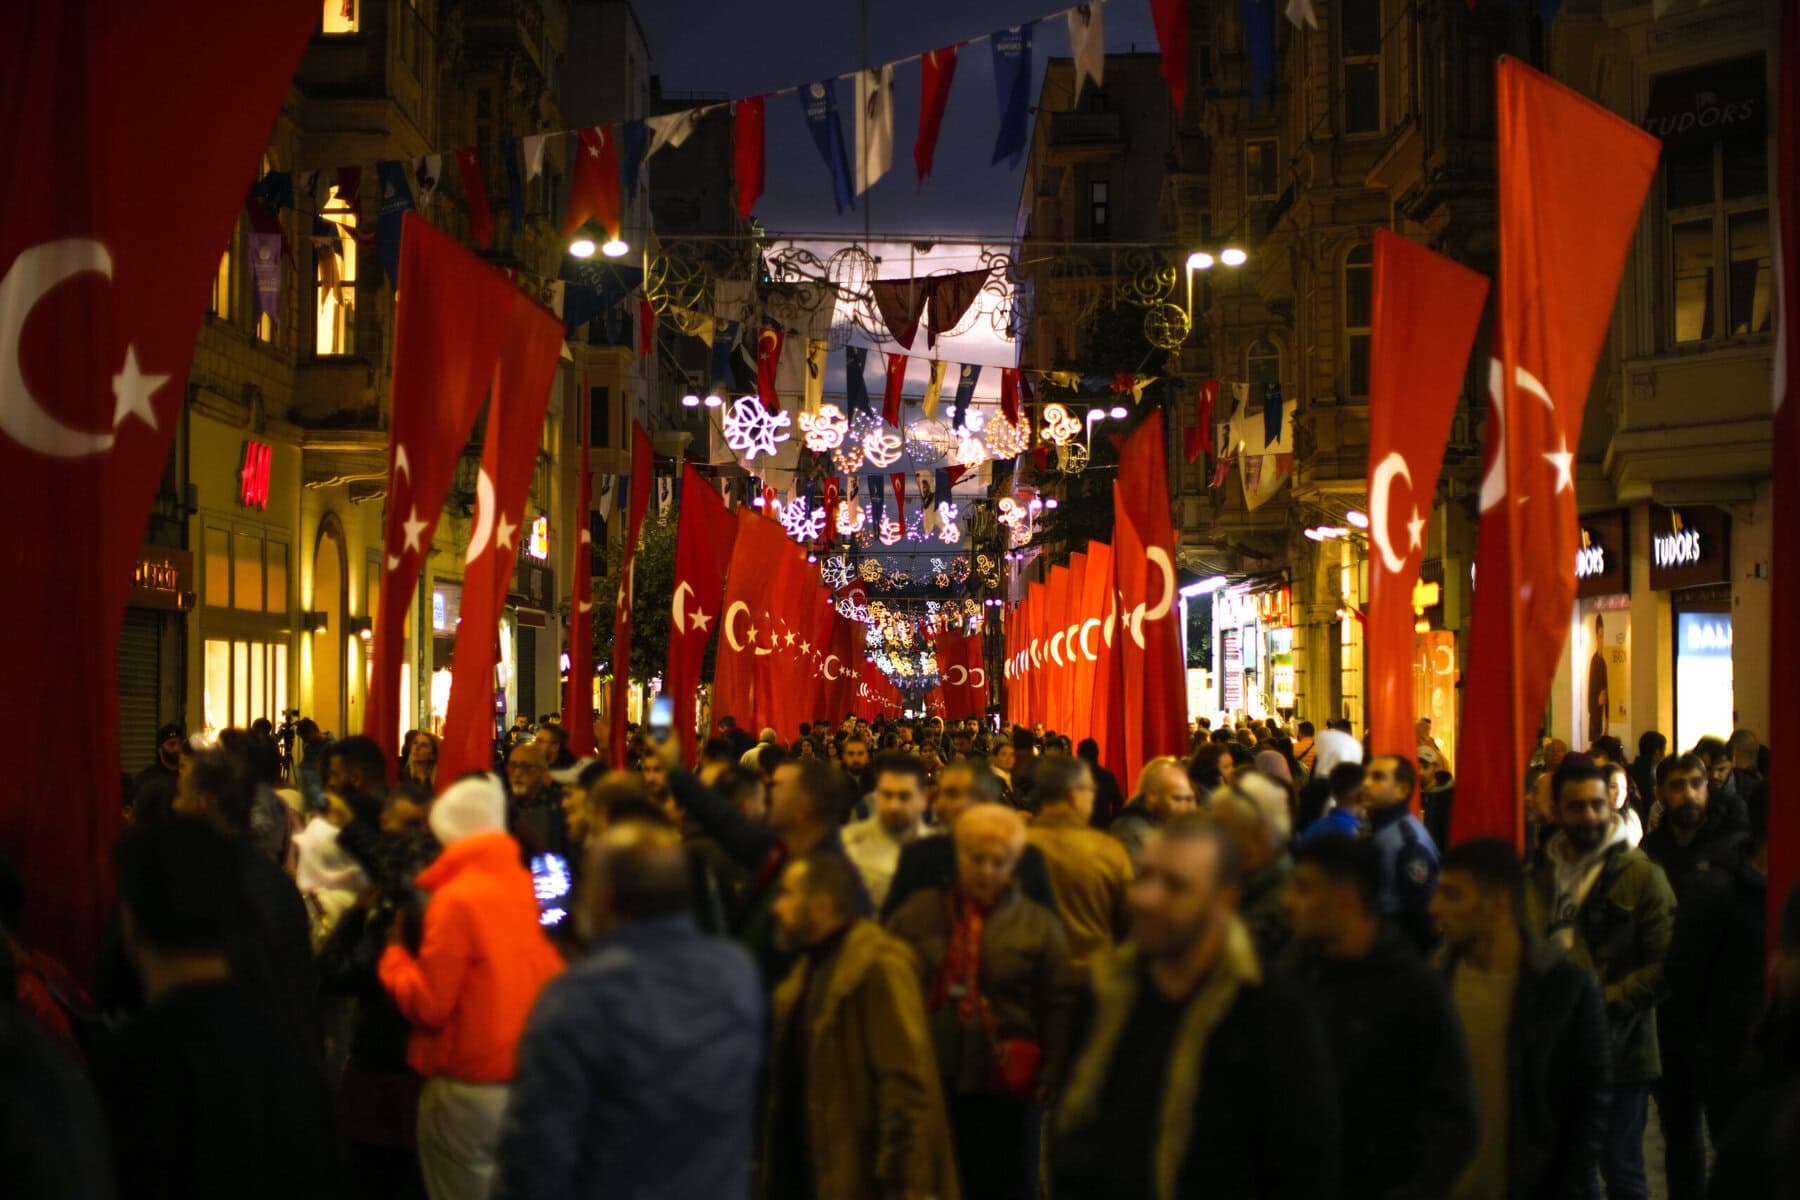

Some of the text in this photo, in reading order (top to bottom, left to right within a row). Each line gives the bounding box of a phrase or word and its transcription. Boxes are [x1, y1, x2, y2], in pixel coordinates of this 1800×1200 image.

[1647, 98, 1753, 136] TUDORS
[1575, 546, 1604, 576] DORS
[1654, 531, 1700, 567] TUDORS
